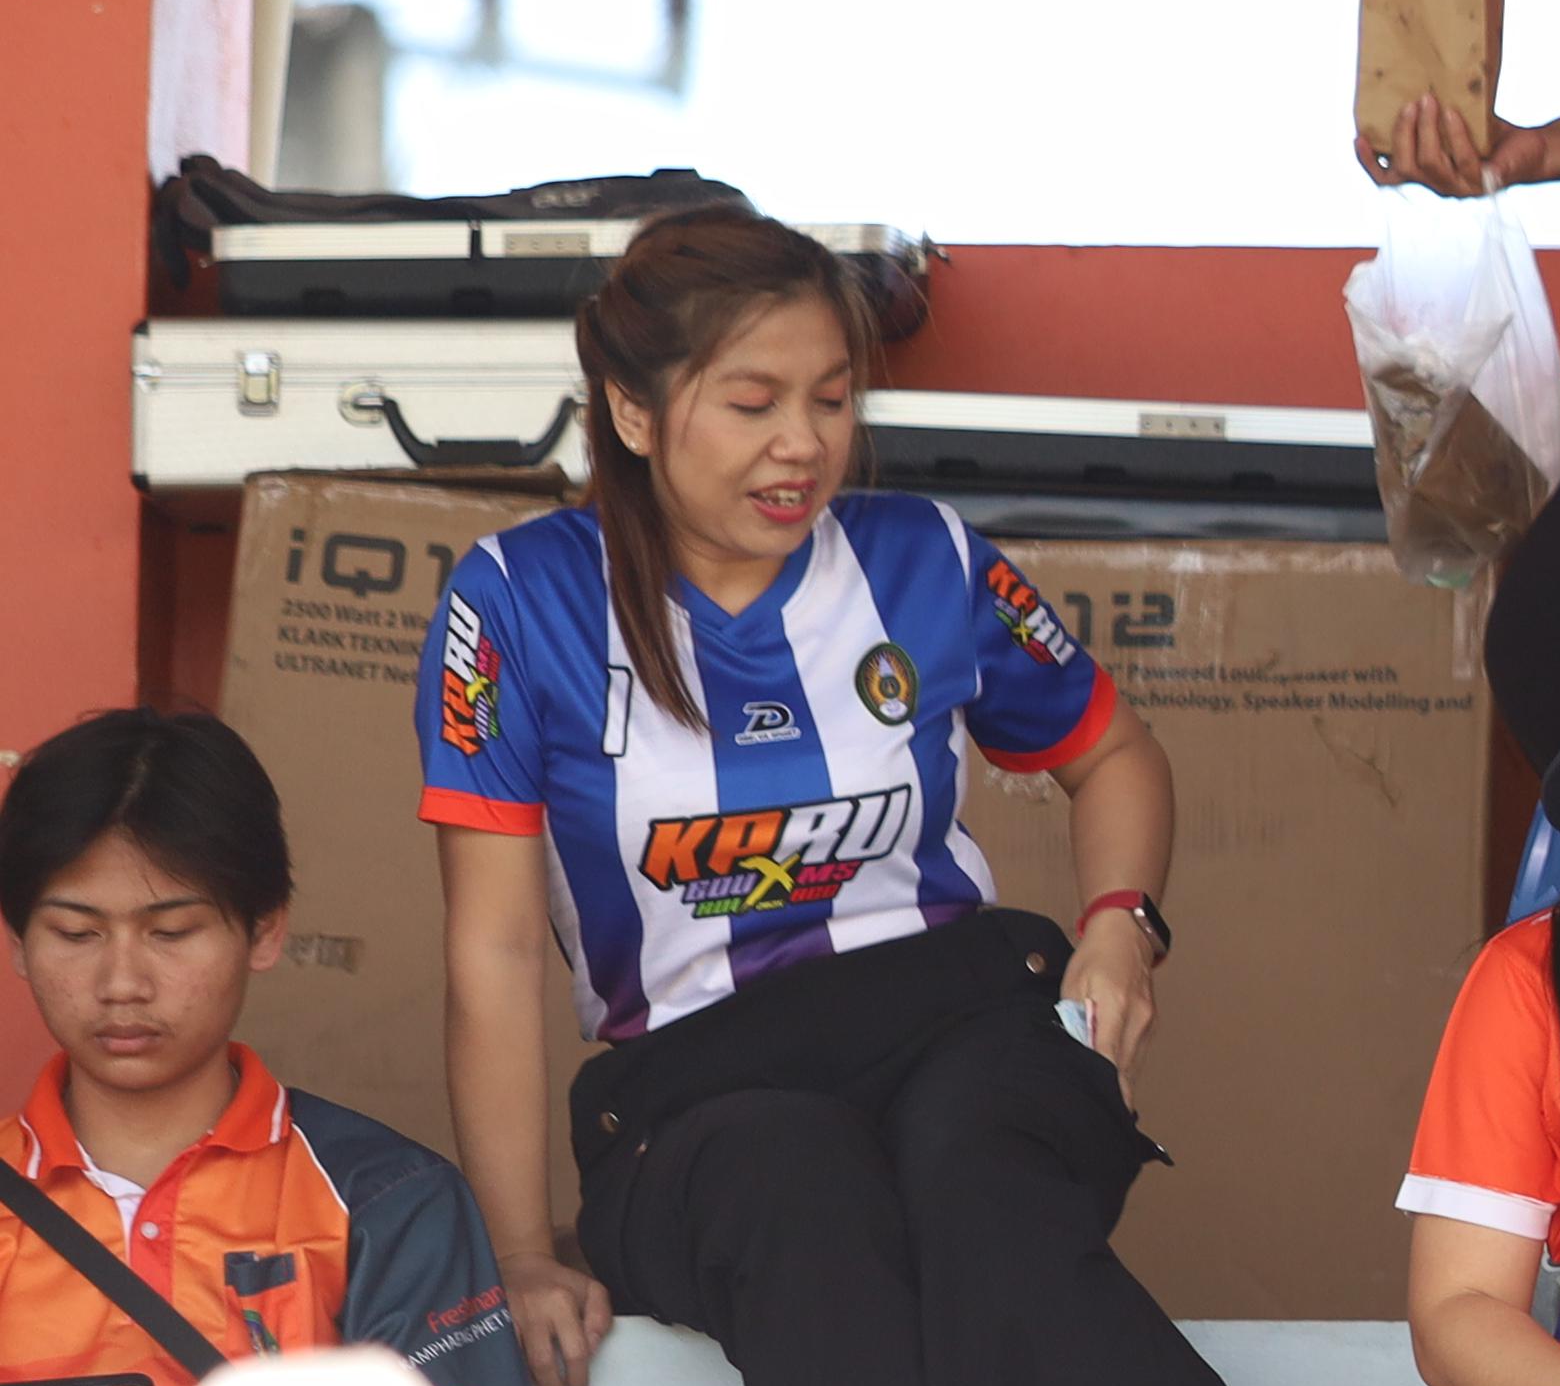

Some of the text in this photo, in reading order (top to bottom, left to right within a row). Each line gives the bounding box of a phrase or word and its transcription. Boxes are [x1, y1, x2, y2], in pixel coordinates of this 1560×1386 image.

[280, 598, 331, 621] 2500
[334, 604, 381, 628] Watt
[986, 559, 1077, 667] KPRU
[278, 625, 345, 651] KLARK
[274, 652, 379, 681] ULTRANET
[440, 587, 483, 757] KPRU
[1127, 663, 1216, 682] Powered
[1353, 666, 1398, 684] with
[1243, 691, 1322, 714] Speaker
[1328, 692, 1430, 717] Modelling
[1434, 692, 1473, 710] and
[639, 784, 911, 891] KPRU
